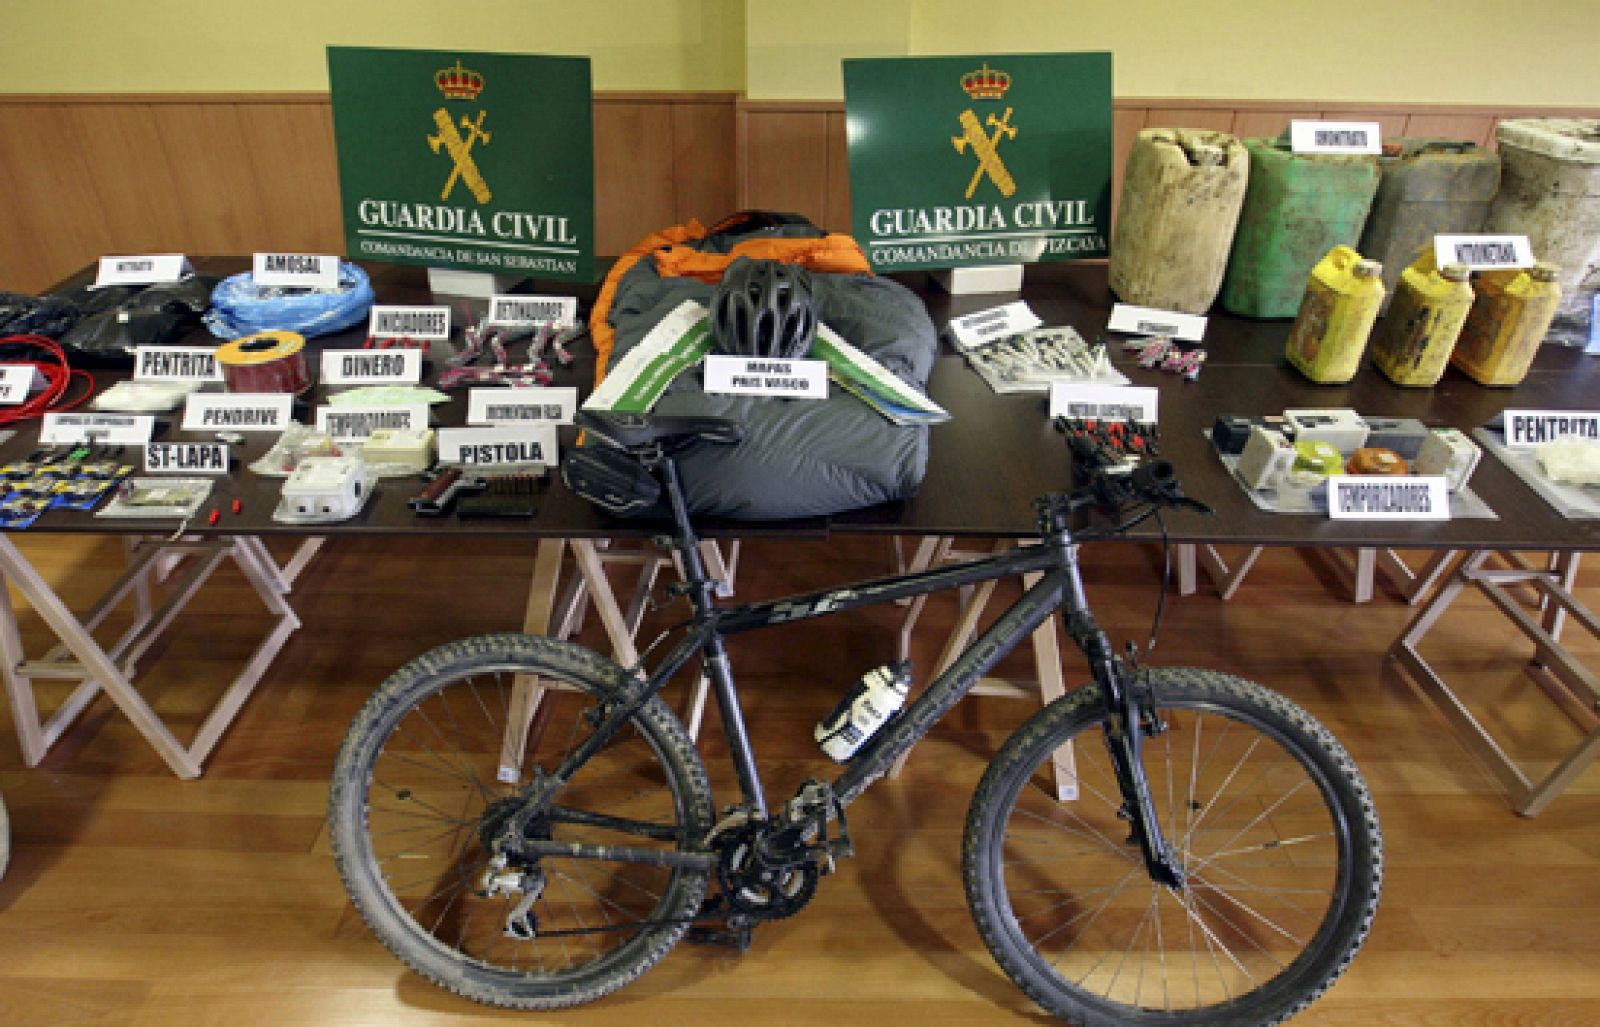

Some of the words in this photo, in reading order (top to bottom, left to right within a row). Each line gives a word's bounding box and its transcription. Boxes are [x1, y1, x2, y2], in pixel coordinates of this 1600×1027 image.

[358, 198, 486, 236] GUARDIA
[492, 212, 577, 244] CIVIL
[869, 204, 1007, 237] GUARDIA
[1014, 200, 1095, 228] CIVIL
[360, 240, 454, 262] COMANDANCIA
[456, 250, 475, 264] DE
[477, 252, 500, 266] SAN
[503, 255, 577, 274] SEBASTIAN
[872, 241, 1007, 266] COMANDANCIA
[378, 311, 445, 333] INICIADORES
[142, 351, 216, 376] PENTRITA
[342, 354, 405, 376] DINERO
[202, 407, 280, 426] PENDRIVE
[148, 445, 225, 468] ST-LAPA
[459, 442, 543, 463] PISTOLA
